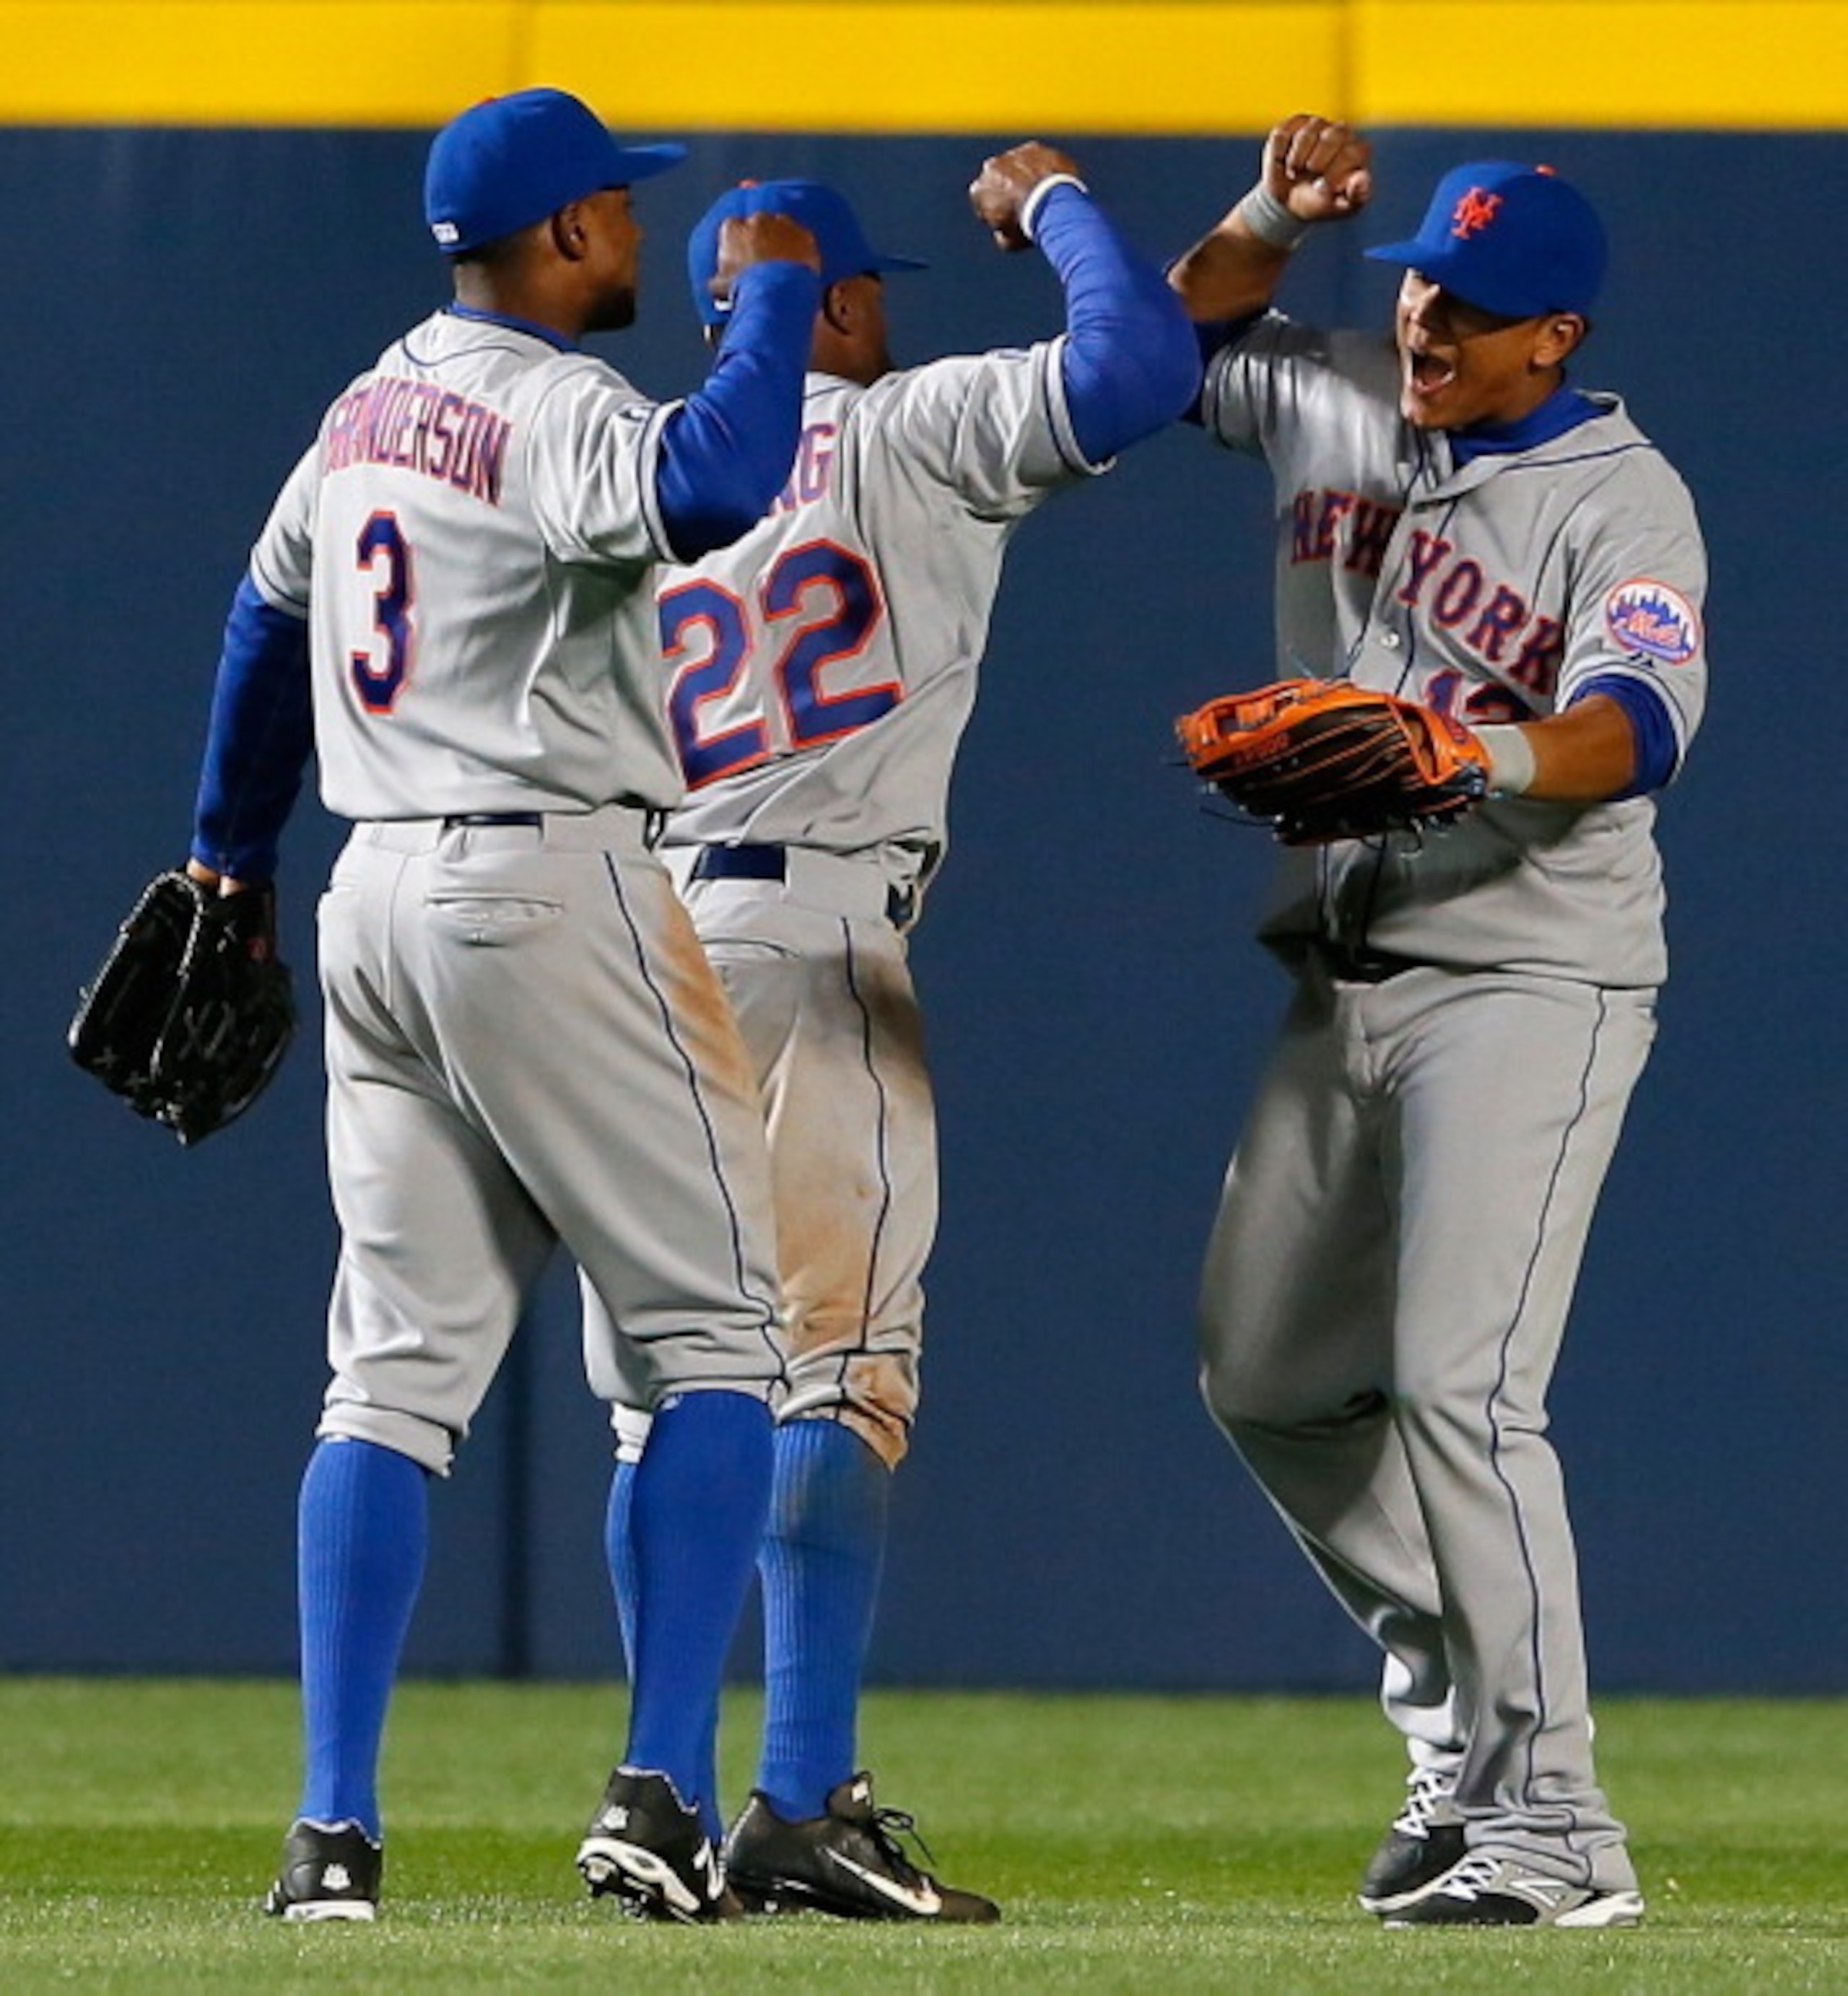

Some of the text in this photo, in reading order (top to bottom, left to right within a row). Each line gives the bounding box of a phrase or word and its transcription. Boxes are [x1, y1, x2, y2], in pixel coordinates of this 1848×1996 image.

[351, 510, 414, 714] 3
[658, 537, 905, 792] 22
[1291, 489, 1565, 694] NEW YORK
